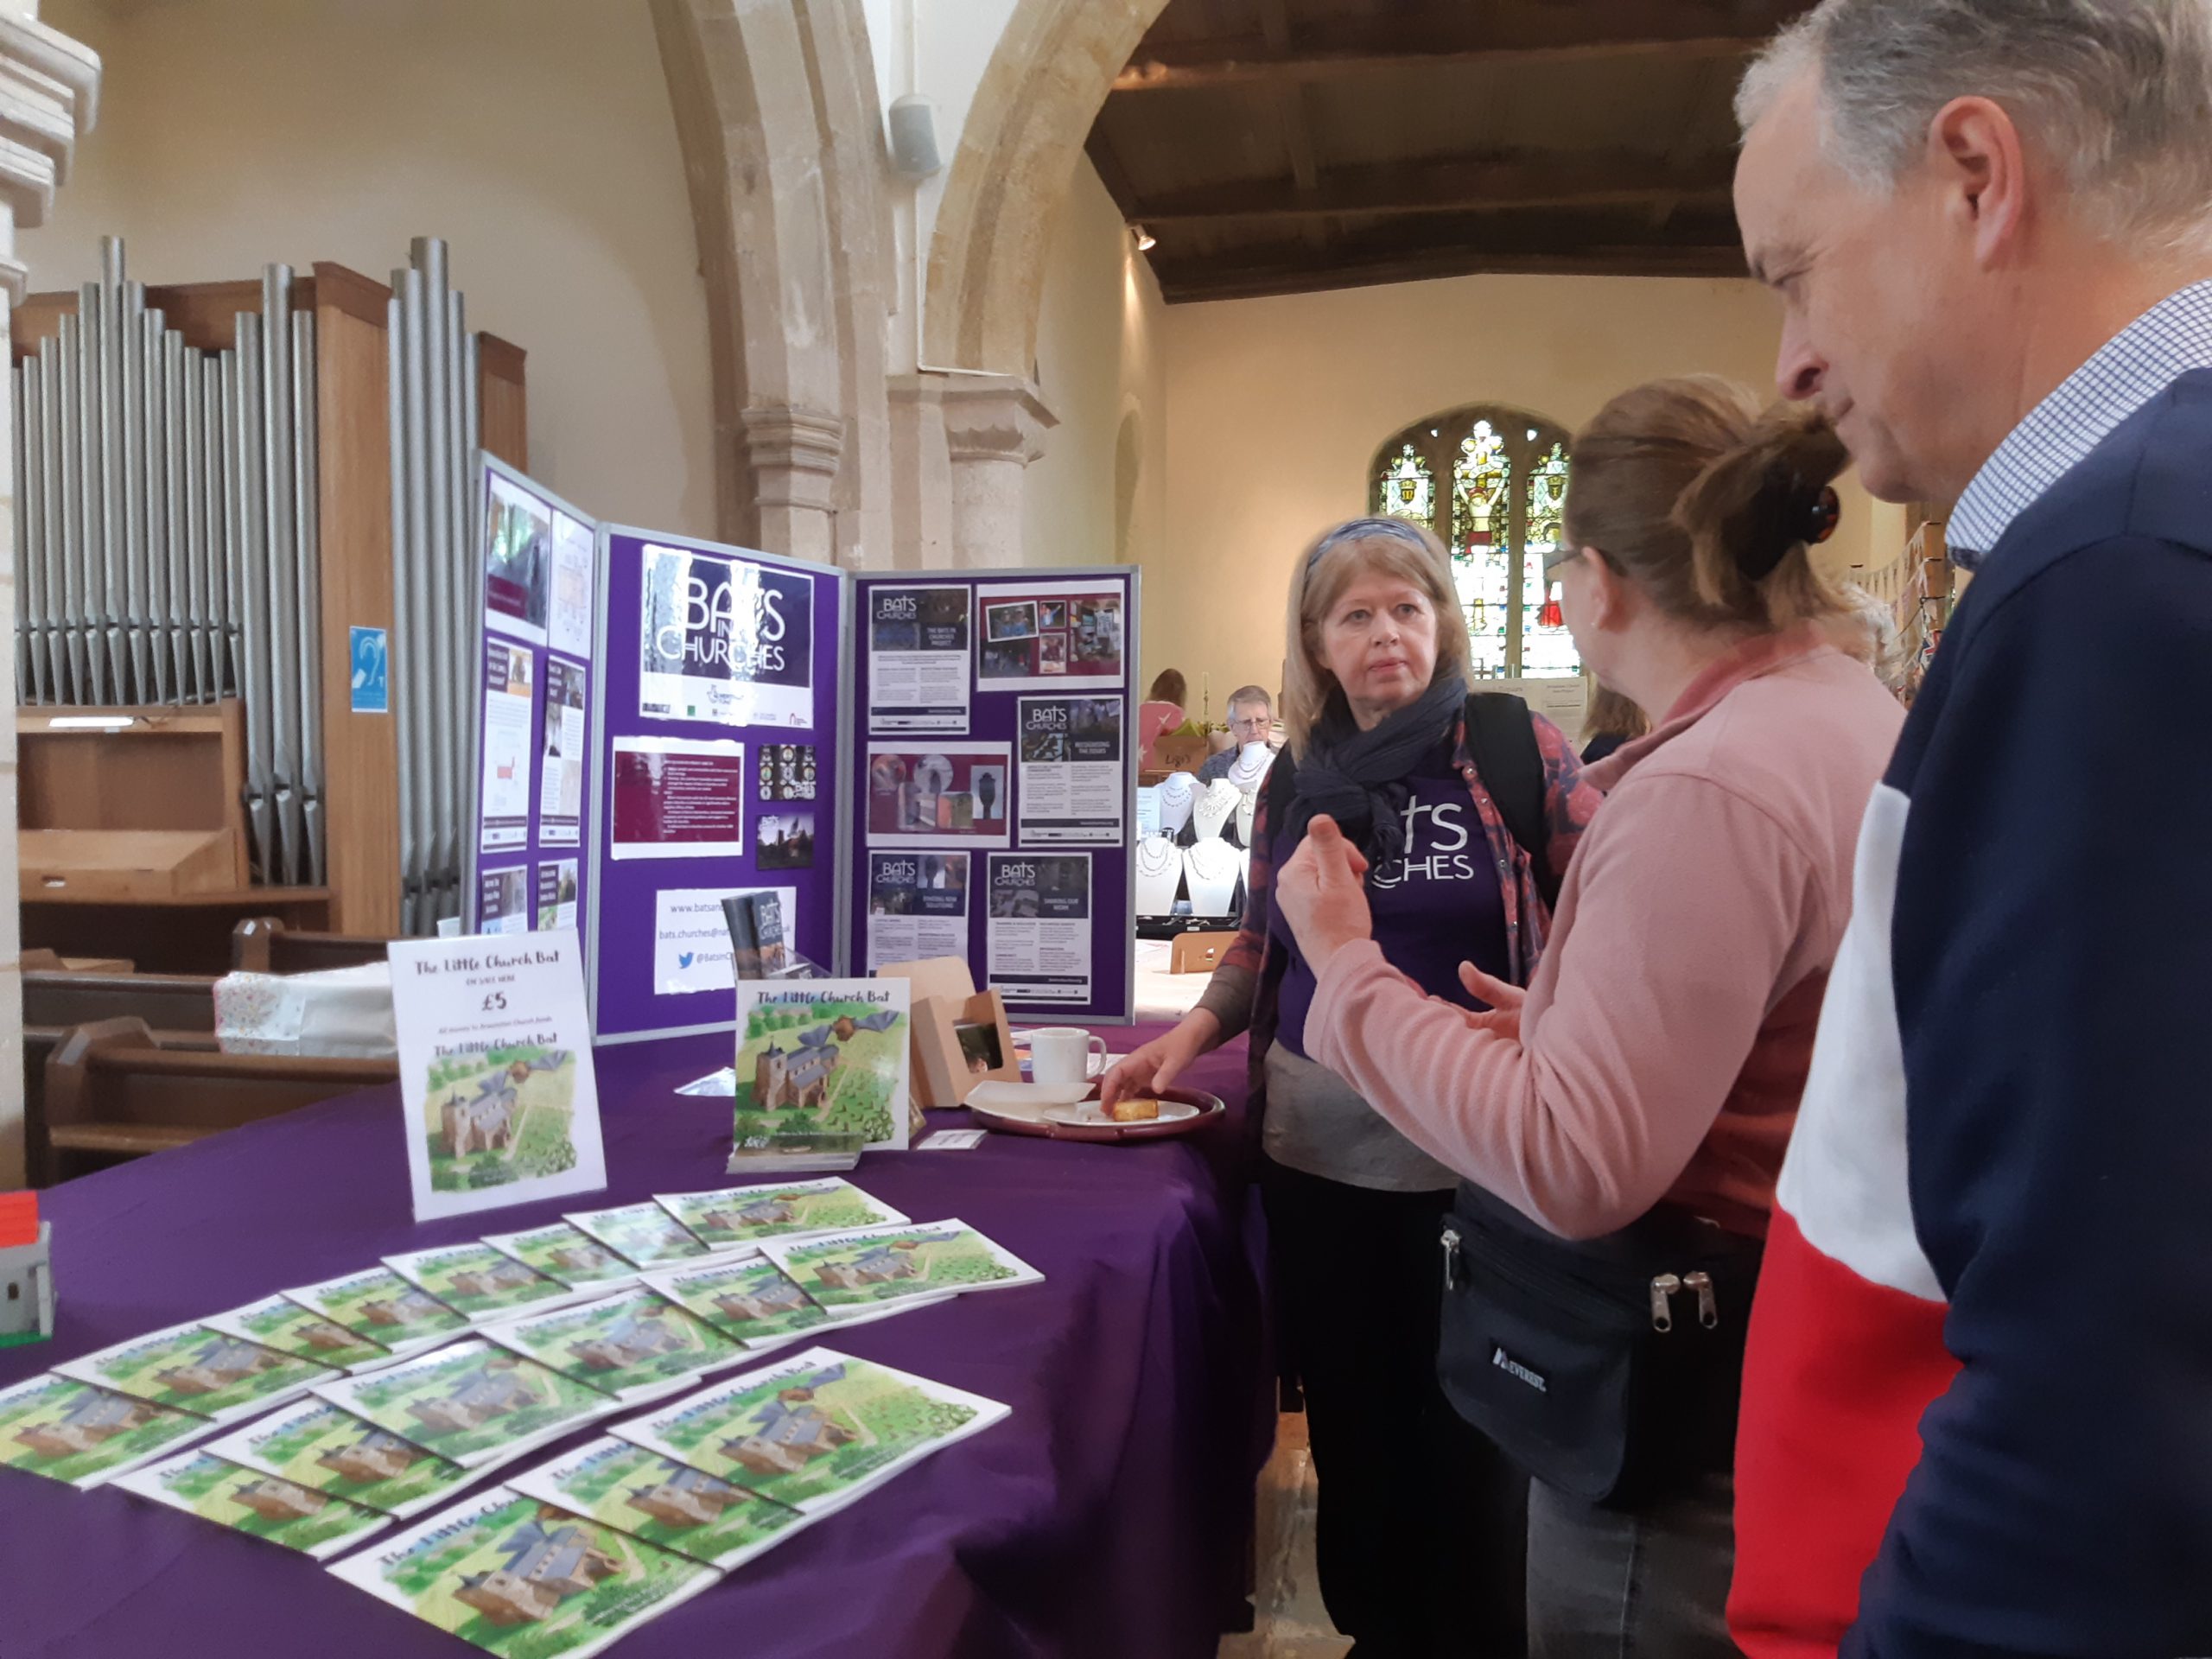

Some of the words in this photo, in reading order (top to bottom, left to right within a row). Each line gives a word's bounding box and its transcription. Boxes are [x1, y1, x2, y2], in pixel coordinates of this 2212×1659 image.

[684, 575, 785, 641] BAS
[883, 594, 917, 612] BATS
[718, 620, 733, 638] IN
[657, 625, 785, 671] CHURCHES
[1033, 706, 1067, 722] BATS
[1400, 795, 1468, 854] TS
[882, 860, 915, 876] BATS
[1002, 861, 1035, 878] BATS
[1371, 855, 1474, 889] CHES
[415, 961, 437, 975] The
[444, 958, 480, 971] Little
[486, 952, 532, 969] Church
[536, 950, 559, 963] Bat
[481, 991, 507, 1011] £5
[758, 991, 778, 1004] The
[784, 991, 815, 1004] Little
[821, 990, 863, 1003] Church
[868, 990, 890, 1002] Bat
[435, 1046, 454, 1058] The
[459, 1042, 490, 1054] Little
[494, 1035, 535, 1051] Church
[537, 1032, 557, 1045] Bat
[790, 1243, 815, 1252] The
[819, 1236, 859, 1249] Little
[652, 1416, 680, 1431] The
[683, 1395, 728, 1418] Little
[729, 1373, 783, 1397] Church
[550, 1464, 582, 1482] The
[378, 1546, 416, 1566] The
[418, 1516, 476, 1547] Little
